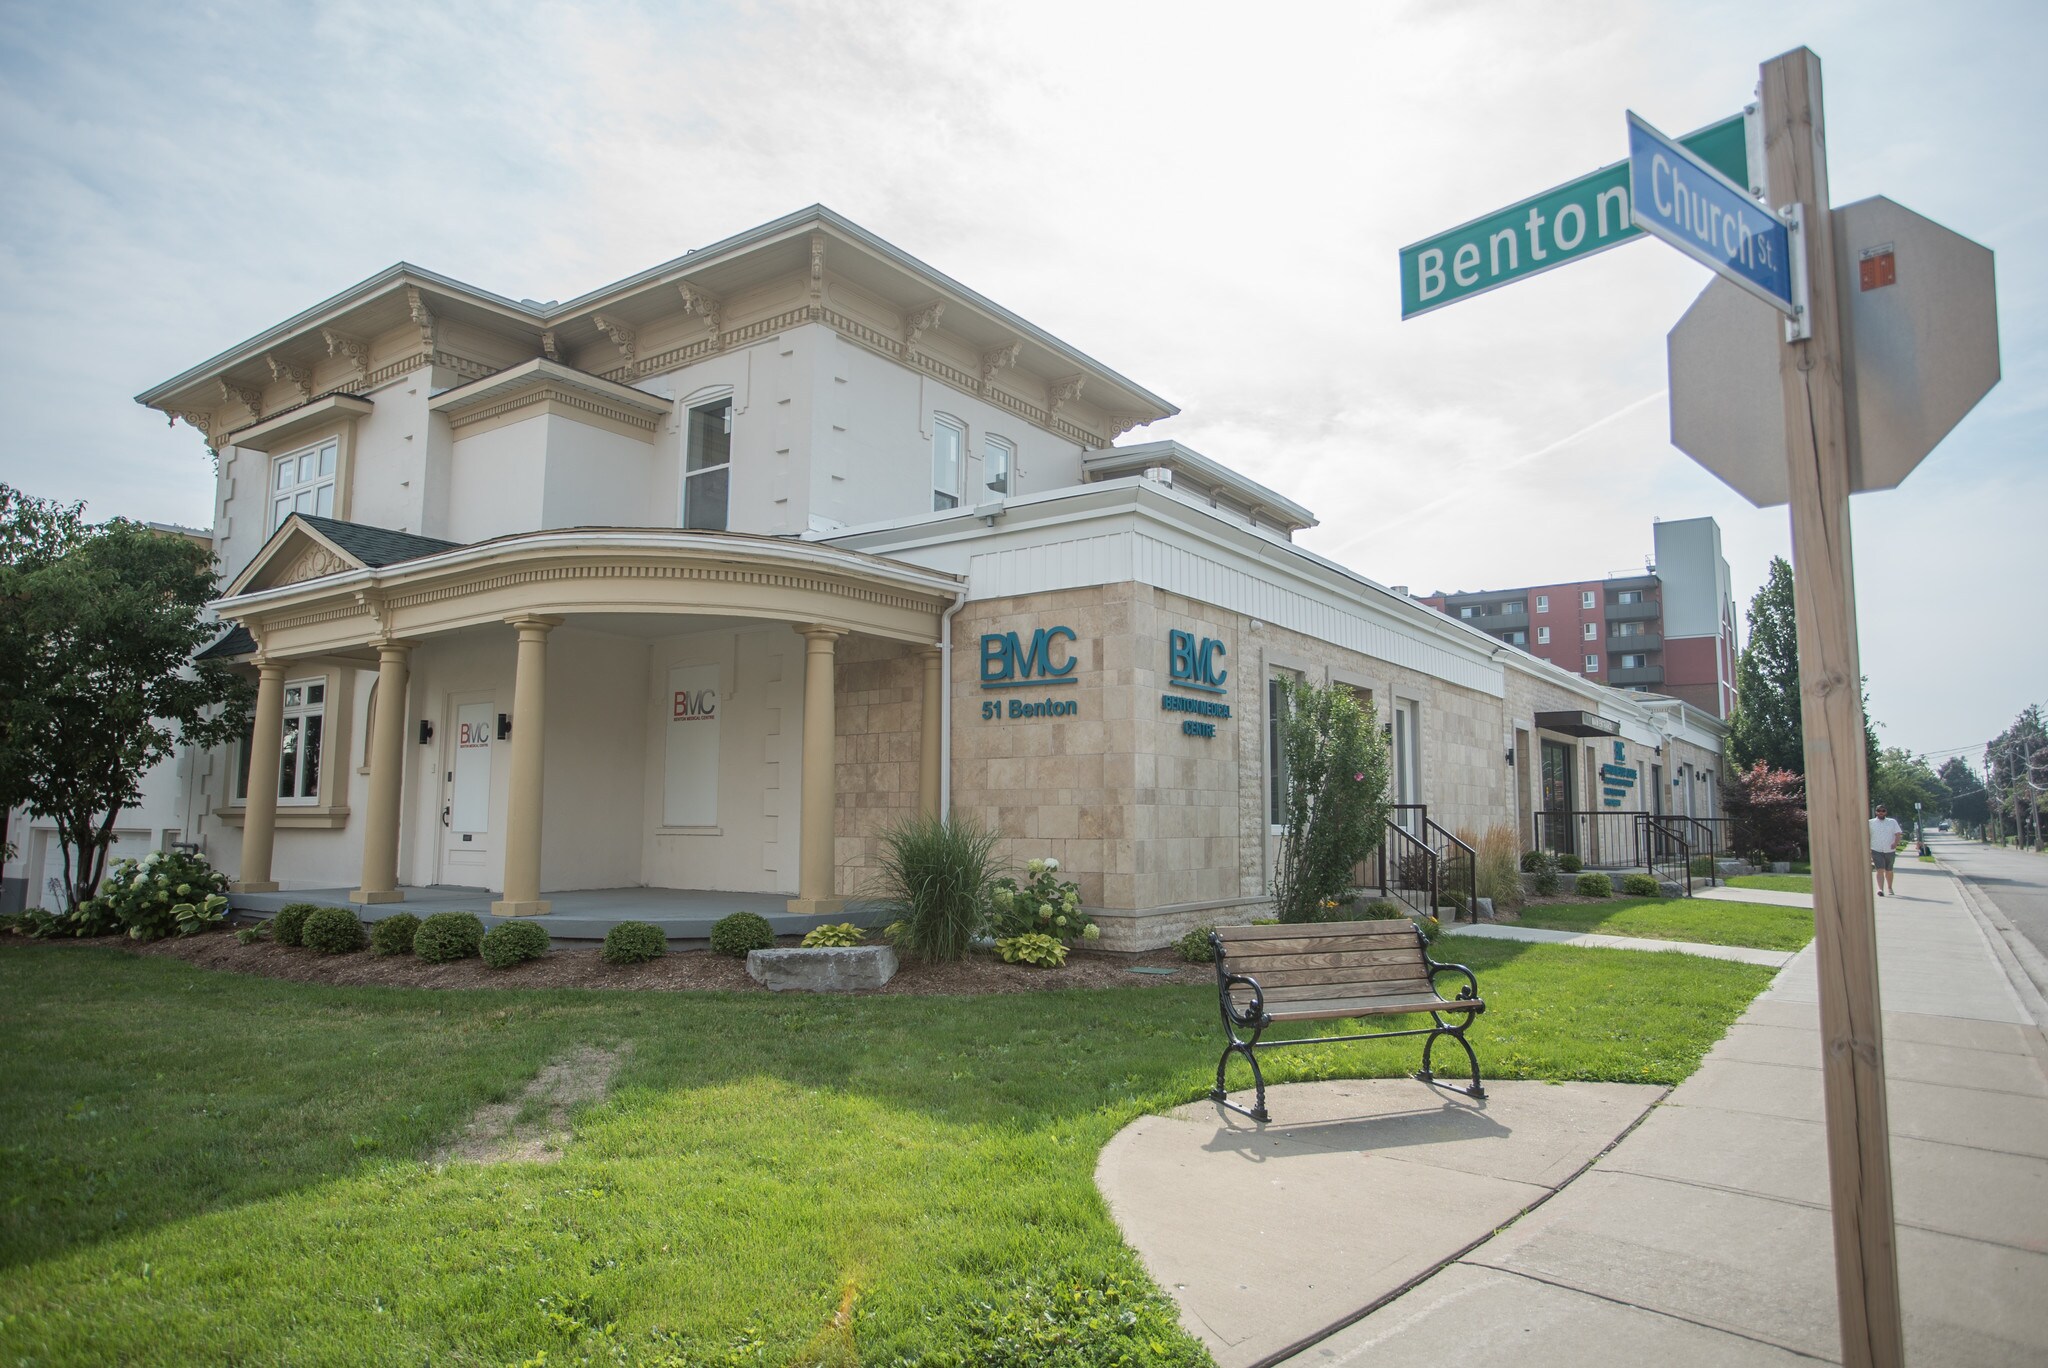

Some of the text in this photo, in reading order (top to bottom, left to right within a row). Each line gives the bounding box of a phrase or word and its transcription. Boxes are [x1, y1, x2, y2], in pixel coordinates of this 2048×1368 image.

[1651, 153, 1778, 273] Church St.
[1417, 184, 1631, 302] Benton
[980, 625, 1078, 682] BMC
[1169, 628, 1227, 686] BMC
[674, 688, 715, 716] BMC
[981, 697, 1078, 720] 51 Benton
[1163, 695, 1232, 718] BENTON MEDICAL
[461, 722, 489, 744] BMC
[1183, 720, 1217, 737] CENTRE
